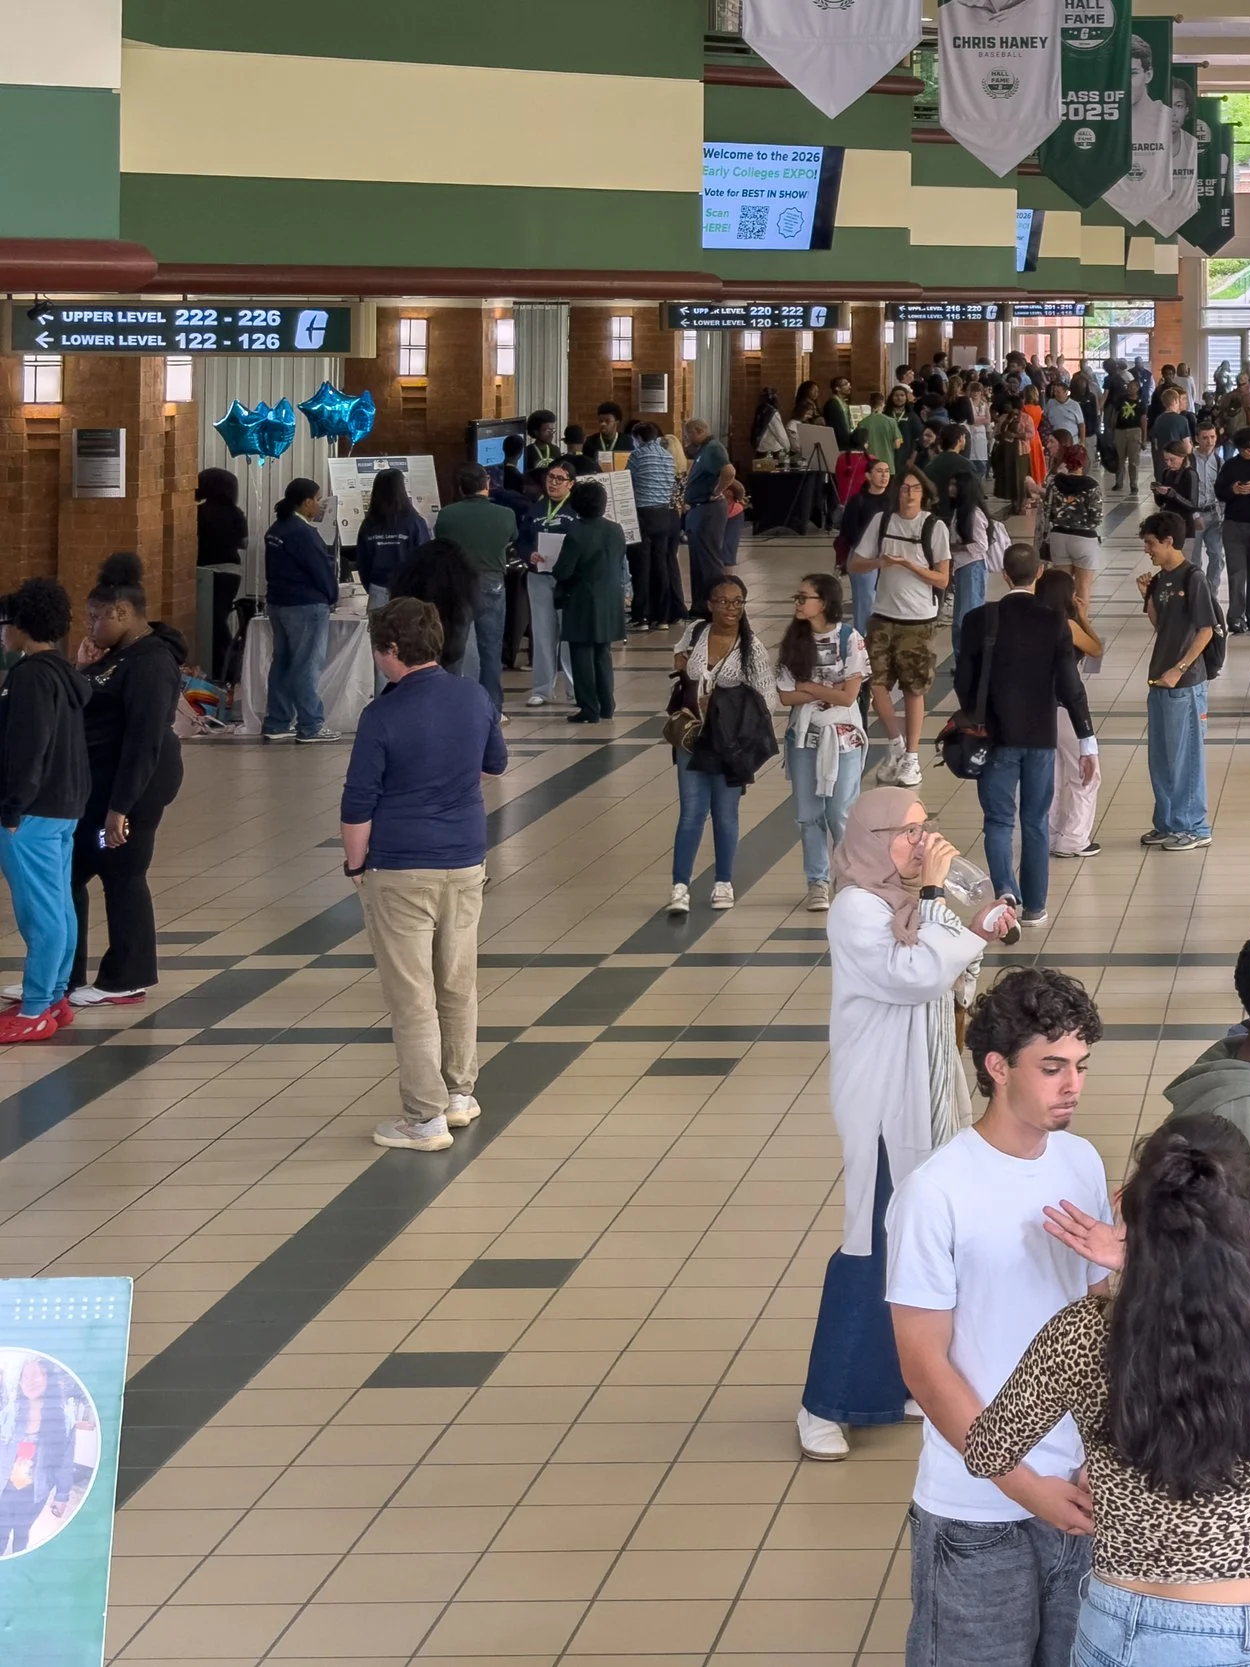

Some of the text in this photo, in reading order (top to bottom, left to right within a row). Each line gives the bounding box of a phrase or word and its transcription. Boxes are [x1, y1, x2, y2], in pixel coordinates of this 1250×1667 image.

[1064, 14, 1105, 24] FAME
[952, 36, 1049, 49] CHRIS HANEY
[1061, 91, 1125, 102] ASS OF
[1131, 143, 1164, 151] GARCIA
[704, 148, 820, 163] Welcome to the 2026
[703, 165, 818, 180] Early Colleges EXPO!
[704, 188, 724, 197] Vote
[726, 188, 740, 198] for
[741, 188, 765, 198] BEST
[766, 189, 777, 199] IN
[1197, 187, 1215, 197] 25
[705, 208, 730, 218] Scan
[703, 223, 731, 233] HERE!
[750, 307, 772, 316] 220
[781, 306, 804, 316] 222
[62, 311, 114, 323] UPPER
[117, 311, 166, 323] LEVEL
[175, 310, 217, 327] 222
[238, 310, 281, 327] 226
[750, 318, 772, 327] 120
[781, 318, 804, 327] 122
[61, 334, 114, 346] LOWER
[118, 334, 166, 346] LEVEL
[175, 333, 217, 349] 122
[238, 333, 280, 349] 126
